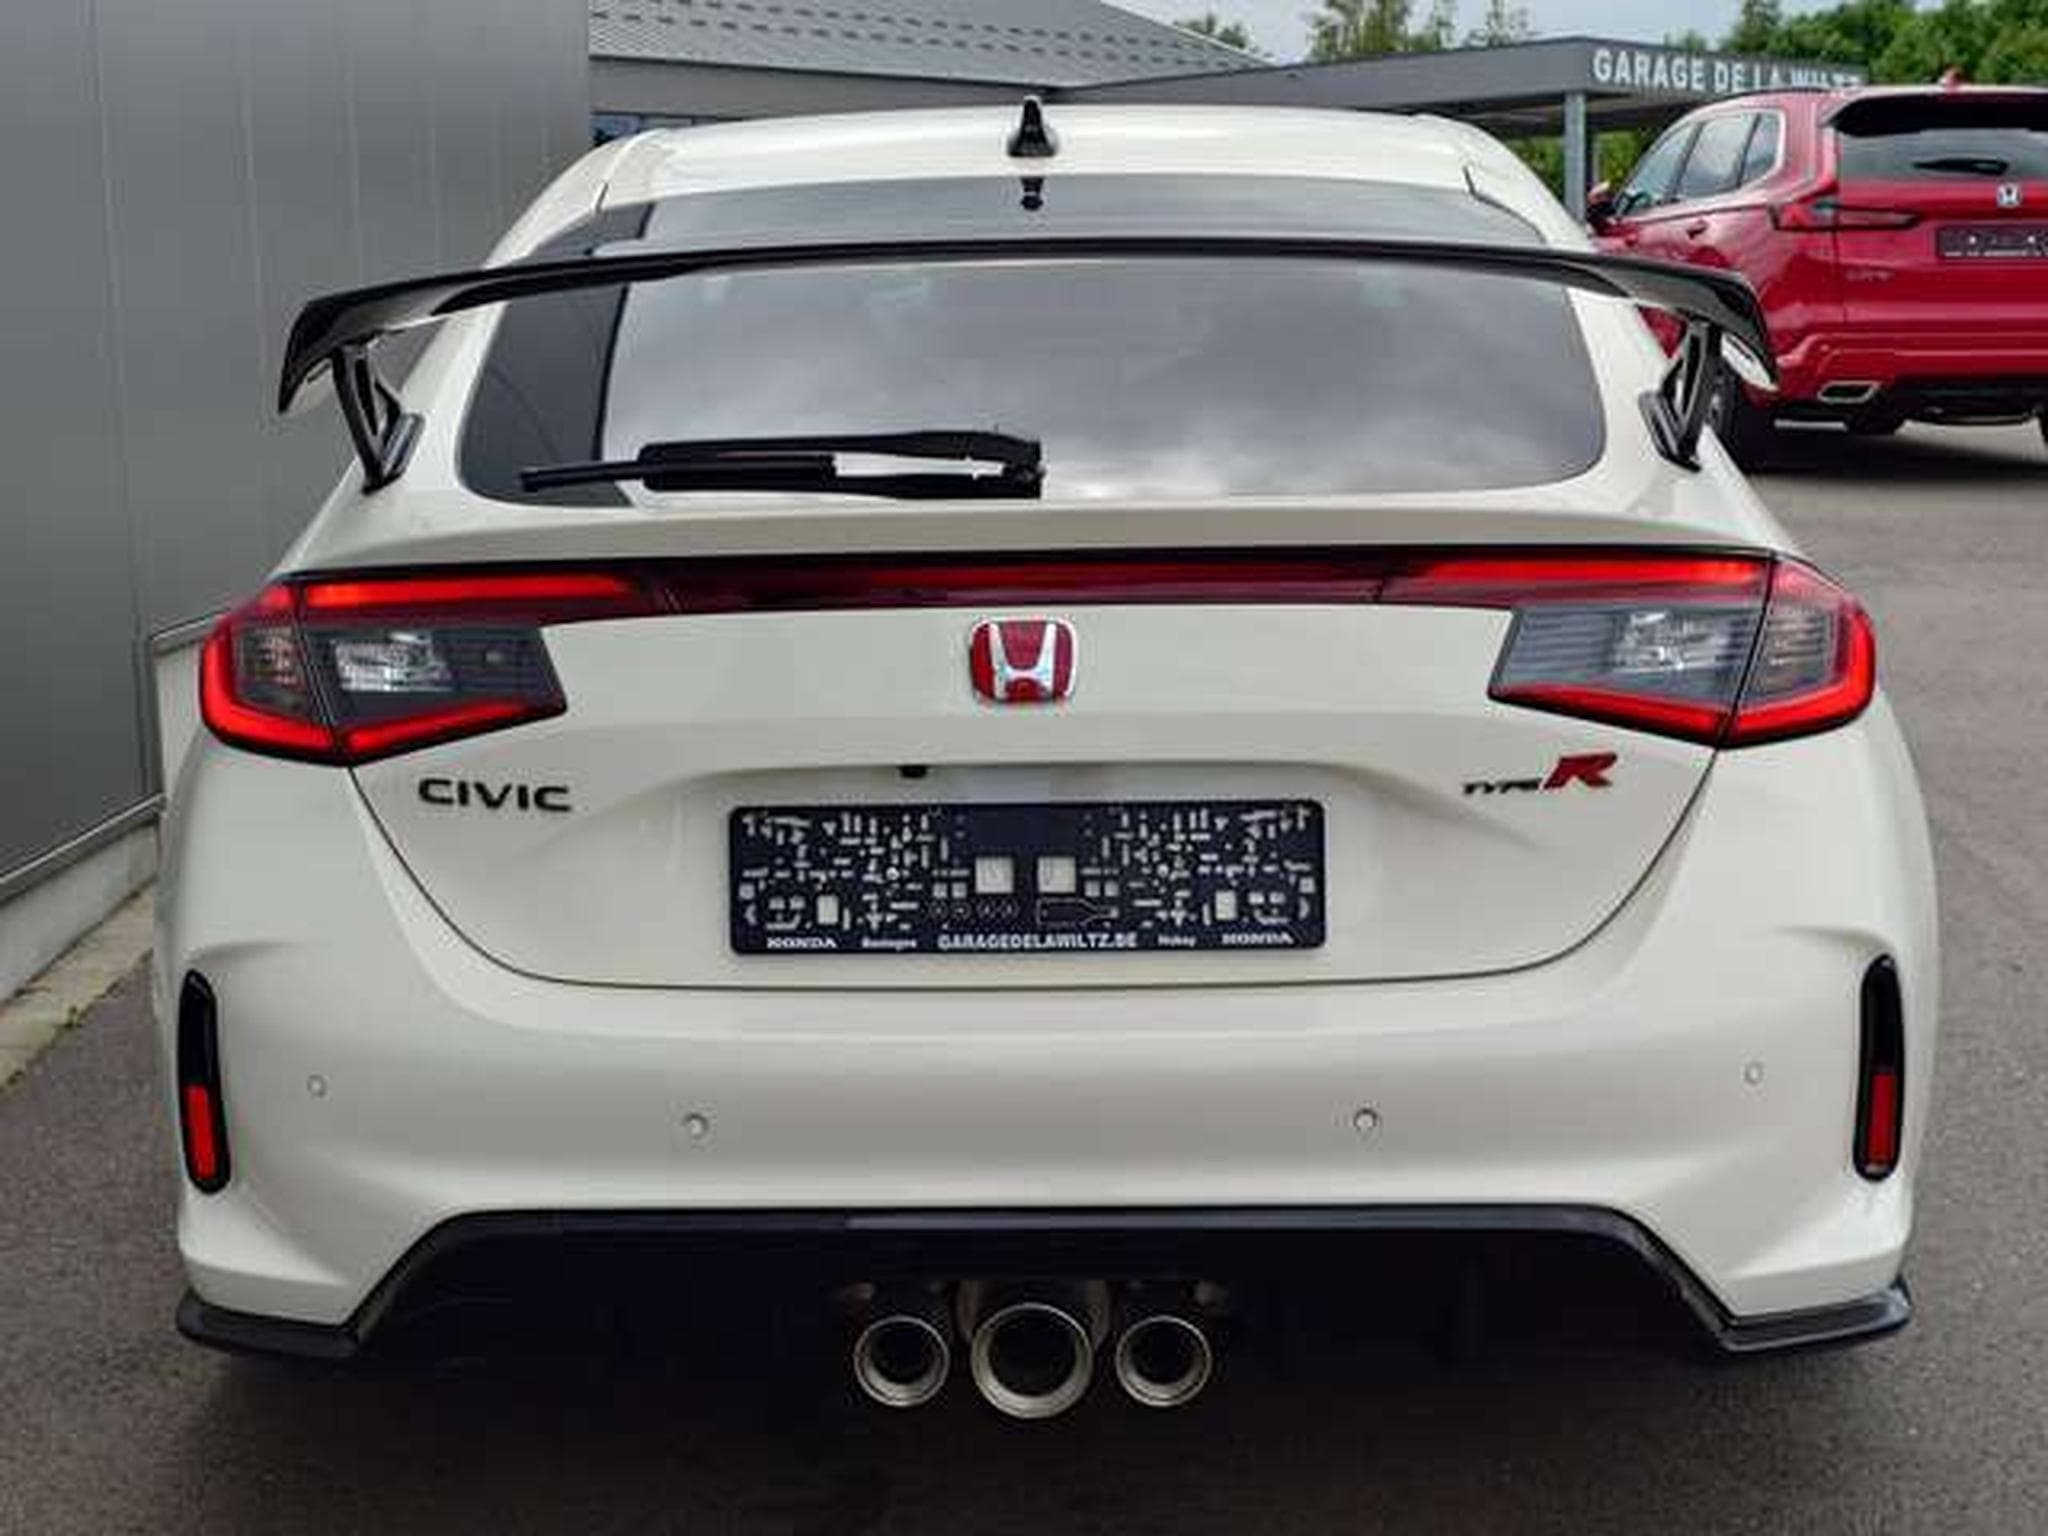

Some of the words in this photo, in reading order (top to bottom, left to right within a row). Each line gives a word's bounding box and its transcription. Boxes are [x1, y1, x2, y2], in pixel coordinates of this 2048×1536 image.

[1593, 49, 1705, 91] GARAGE
[1714, 62, 1746, 93] DE
[1752, 64, 1783, 90] LA
[1543, 752, 1618, 791] R
[418, 777, 572, 812] CIVIC
[766, 936, 837, 949] HONDA
[1221, 933, 1294, 945] HONDA
